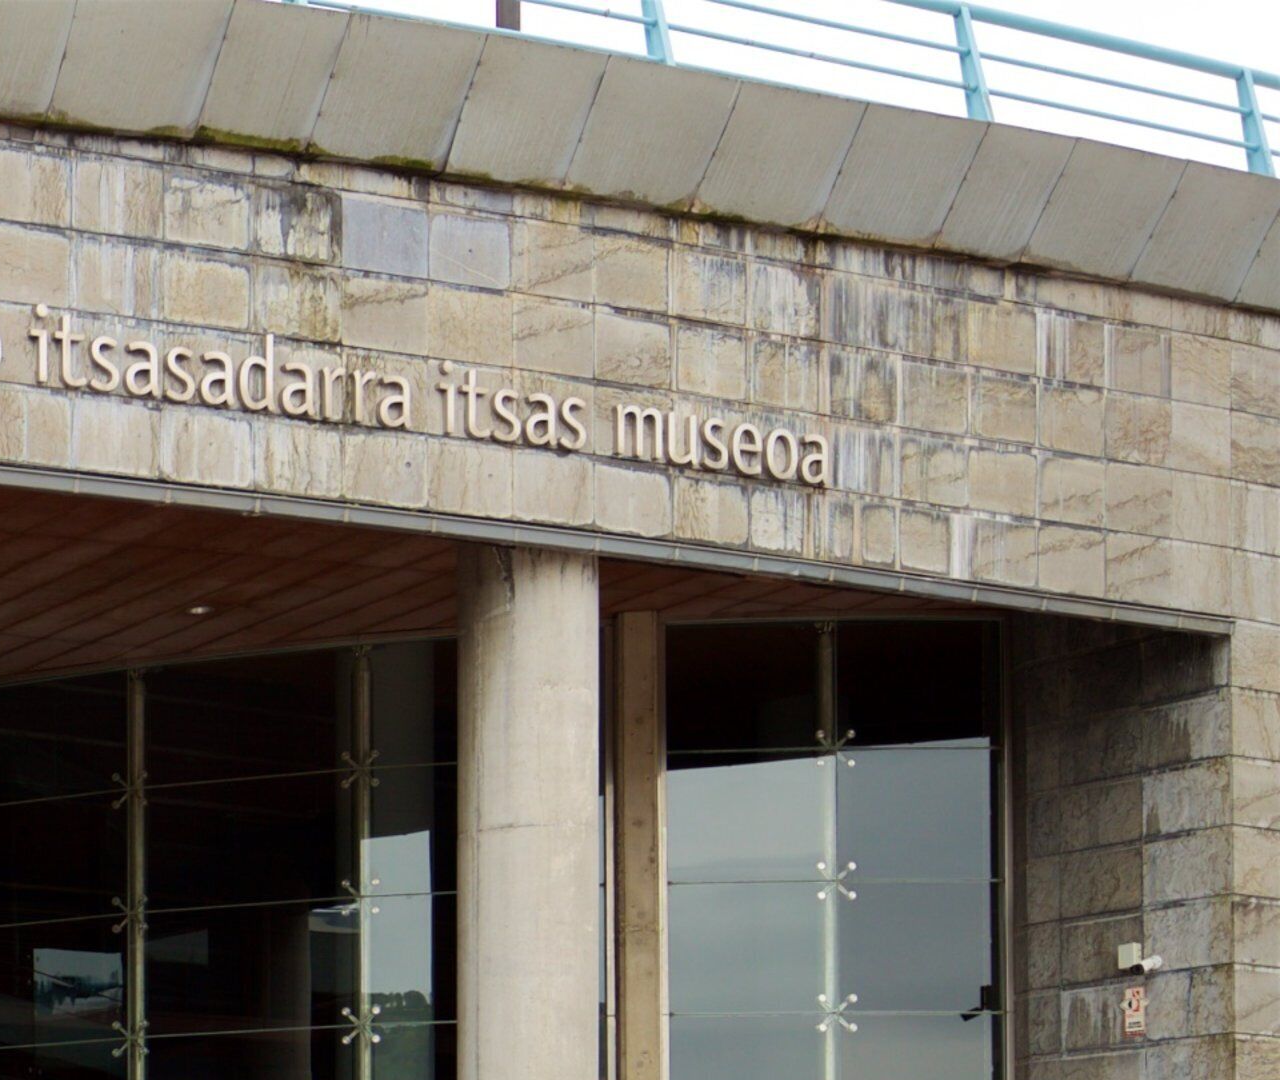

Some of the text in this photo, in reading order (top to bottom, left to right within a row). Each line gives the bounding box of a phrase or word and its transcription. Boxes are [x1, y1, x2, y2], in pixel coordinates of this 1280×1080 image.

[29, 303, 412, 429] itsasadarra
[436, 359, 586, 452] itsas
[615, 402, 831, 485] museoa
